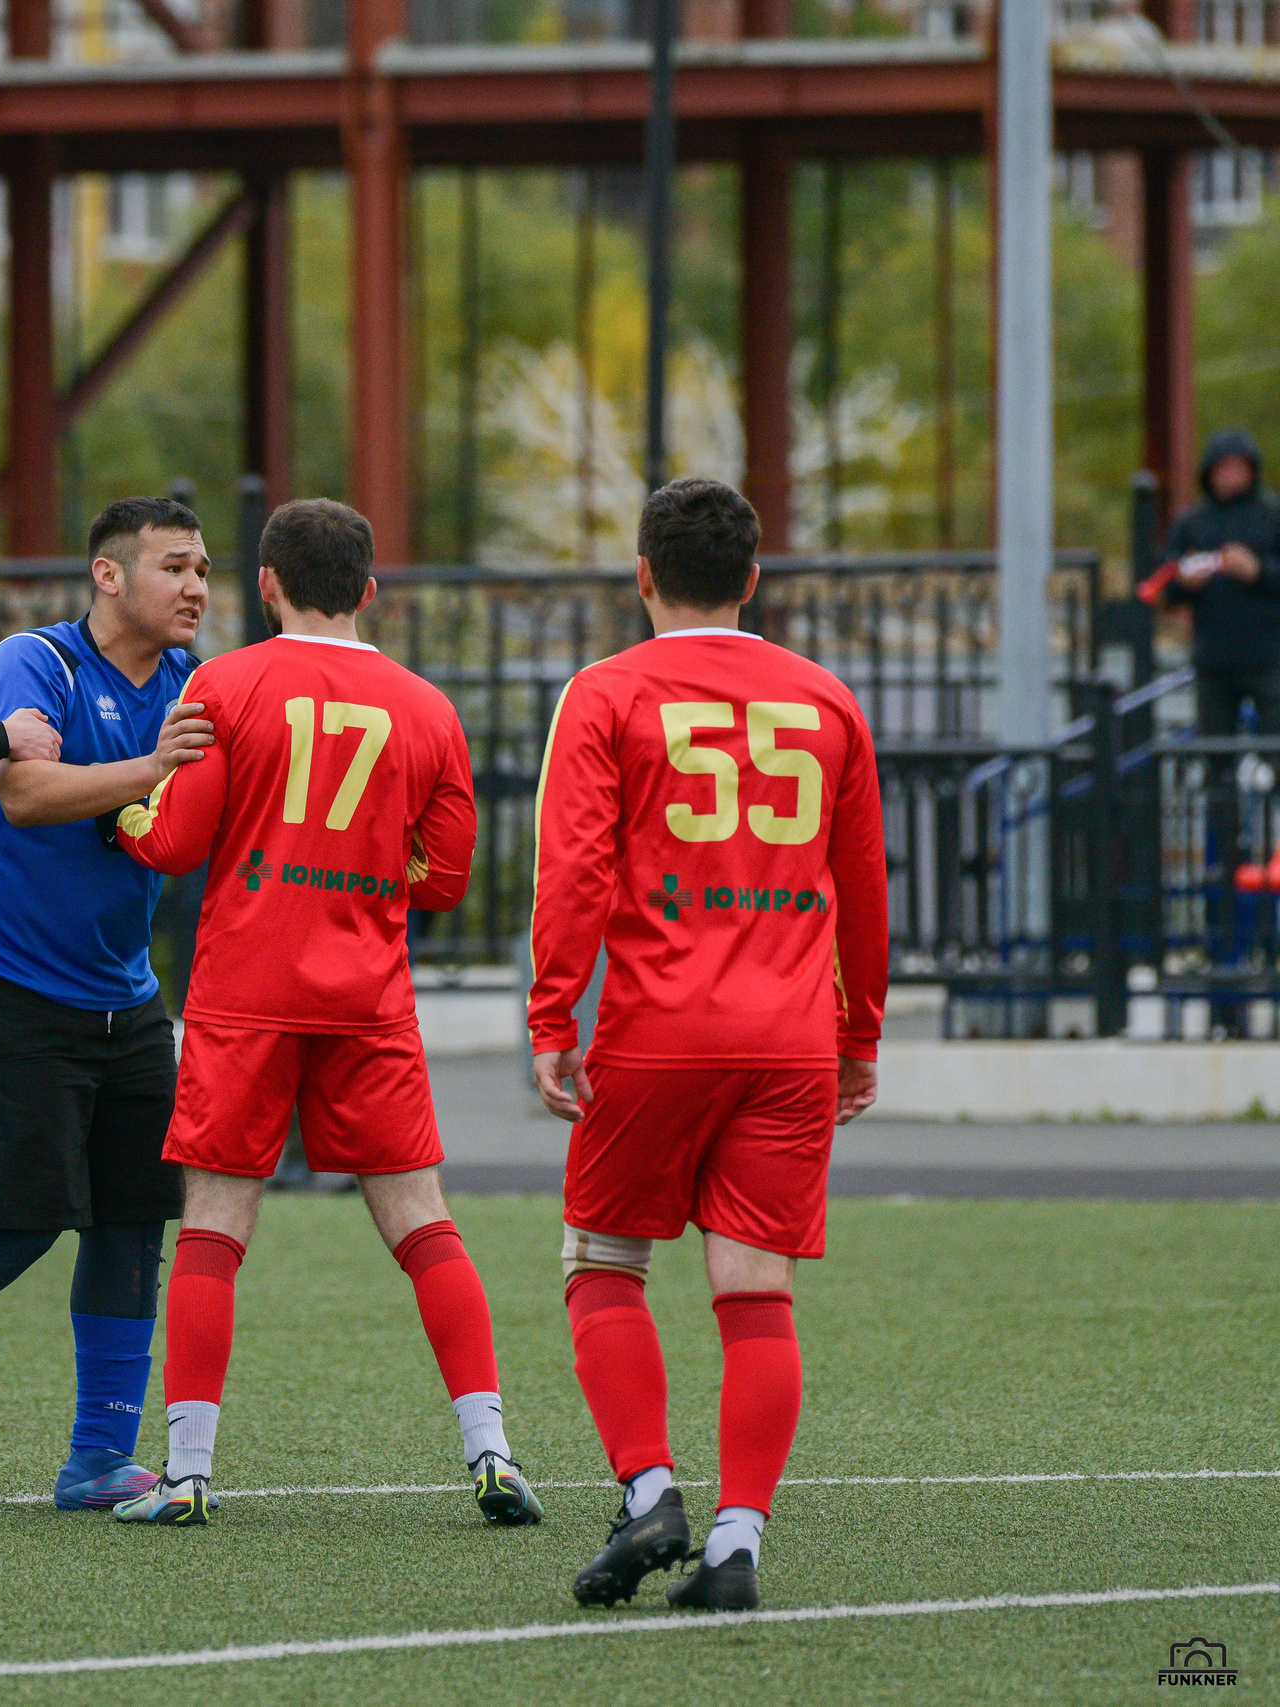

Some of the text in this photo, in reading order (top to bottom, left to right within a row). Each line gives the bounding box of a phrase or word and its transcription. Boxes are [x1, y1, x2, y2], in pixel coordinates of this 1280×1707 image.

[100, 711, 121, 720] errea
[282, 696, 392, 831] 17
[660, 701, 823, 845] 55
[281, 863, 398, 899] ЮНИРОН
[704, 887, 827, 913] ЮНИРОН
